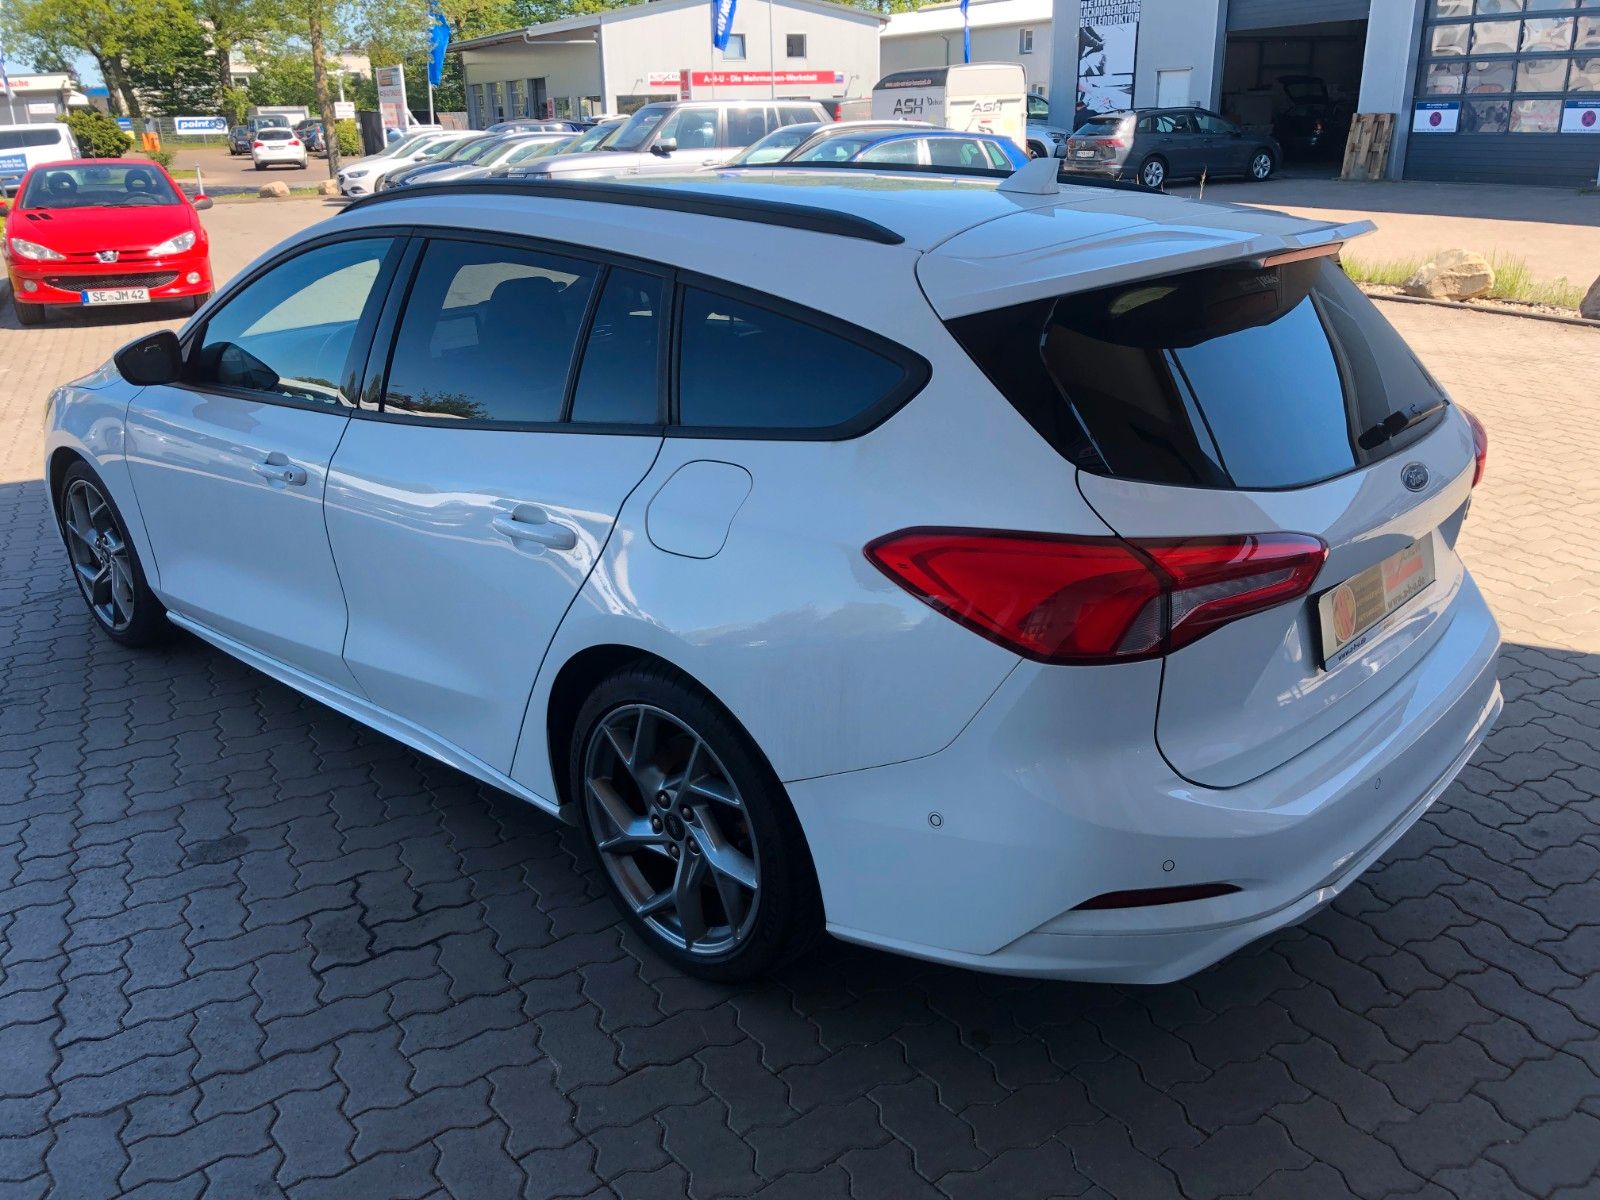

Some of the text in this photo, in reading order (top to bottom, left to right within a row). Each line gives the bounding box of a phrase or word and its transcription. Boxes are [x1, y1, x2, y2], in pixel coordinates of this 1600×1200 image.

[1080, 2, 1141, 18] LACKAUFBEREITUNG
[1080, 13, 1140, 28] BEULENDOKTOR
[730, 74, 742, 83] Die
[893, 98, 923, 115] ASH
[972, 102, 1003, 113] ASH
[180, 120, 210, 130] point
[92, 290, 144, 302] SE JM 42
